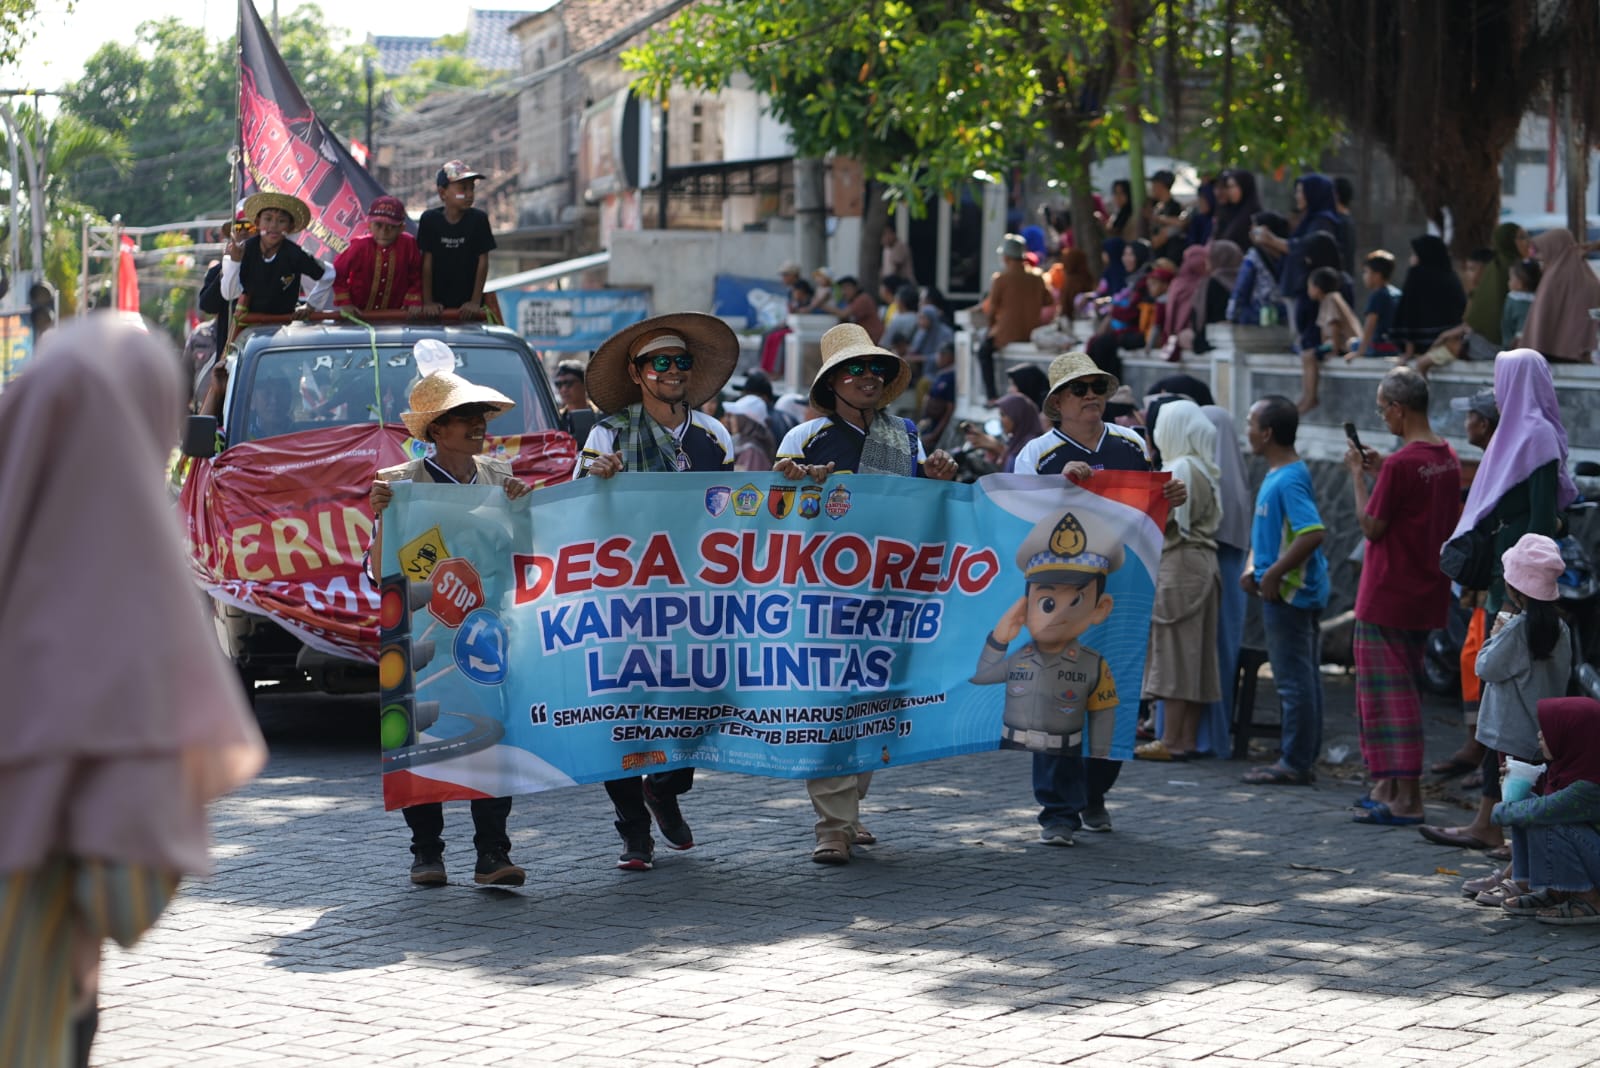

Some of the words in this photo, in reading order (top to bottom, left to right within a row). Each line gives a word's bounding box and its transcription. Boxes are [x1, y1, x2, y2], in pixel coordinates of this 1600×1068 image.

[512, 532, 687, 605] DESA
[698, 531, 999, 595] SUKOREJO
[437, 571, 477, 612] STOP
[539, 595, 790, 652] KAMPUNG
[800, 595, 942, 640] TERTIB
[588, 646, 729, 694] LALU
[738, 646, 892, 690] LINTAS
[1057, 670, 1087, 683] POLRI
[553, 705, 641, 727] SEMANGAT
[643, 704, 782, 724] KEMERDEKAAN
[785, 707, 844, 723] HARUS
[845, 698, 891, 720] DIIRINGI
[892, 692, 945, 710] DENGAN
[612, 723, 717, 742] SEMANGAT
[719, 721, 783, 745] TERTIB
[784, 725, 855, 745] BERLALU
[855, 716, 896, 738] LINTAS
[671, 751, 720, 762] SPARTAN
